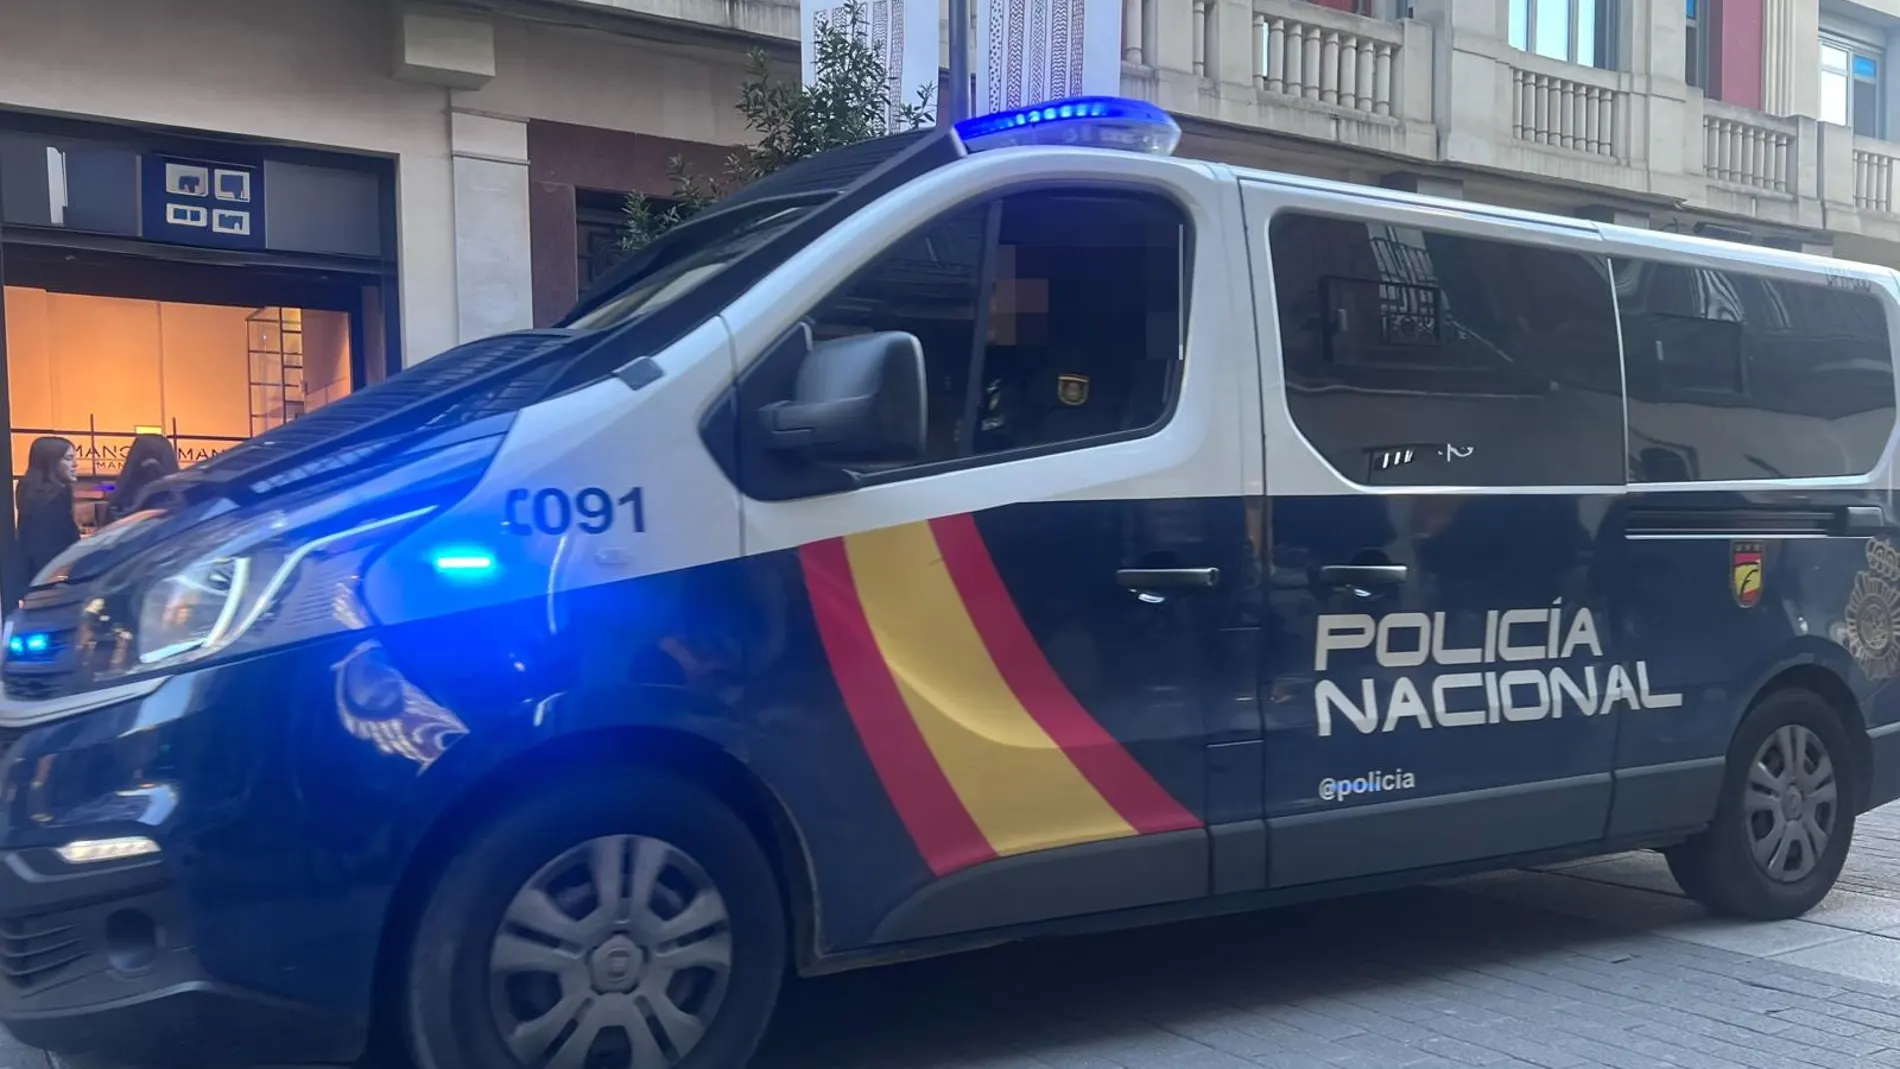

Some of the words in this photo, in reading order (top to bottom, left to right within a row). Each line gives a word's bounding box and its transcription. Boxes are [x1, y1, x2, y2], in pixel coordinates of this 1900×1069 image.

[1314, 596, 1604, 672] POLICÍA
[1314, 660, 1683, 737] NACIONAL
[1318, 767, 1416, 802] @policia
